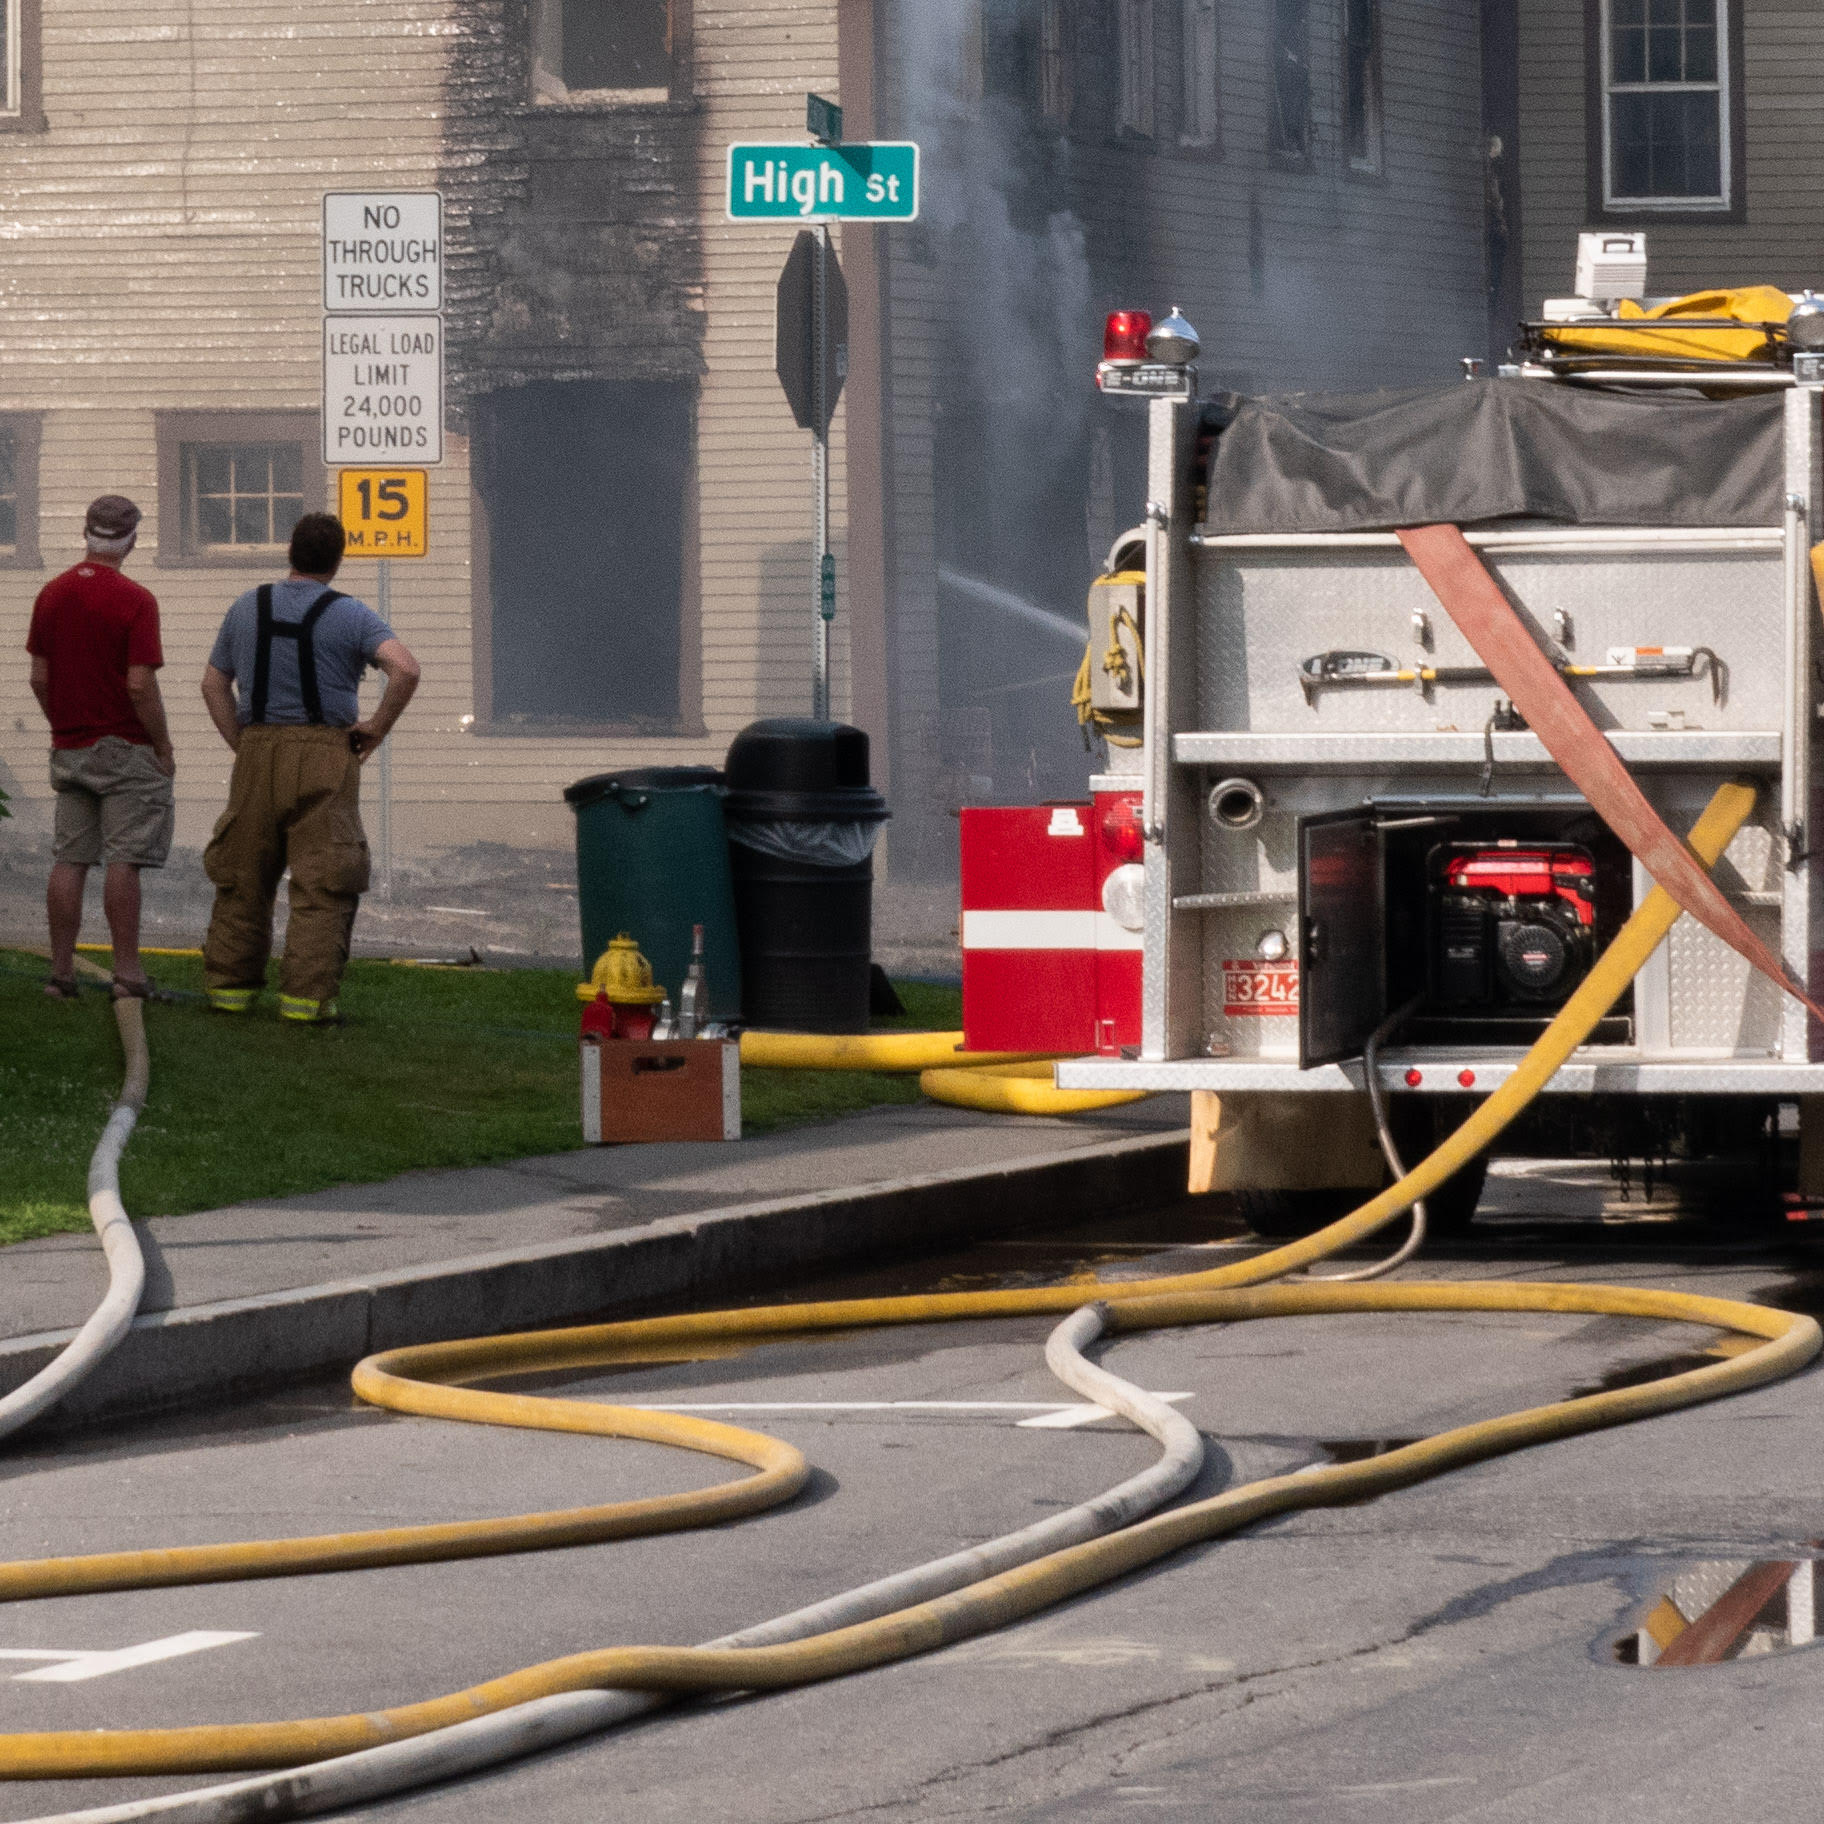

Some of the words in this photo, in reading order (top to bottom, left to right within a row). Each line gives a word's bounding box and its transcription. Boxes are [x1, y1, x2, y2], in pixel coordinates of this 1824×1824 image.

[743, 160, 844, 214] High
[865, 172, 900, 203] St
[364, 205, 401, 229] NO
[329, 240, 437, 264] THROUGH
[336, 274, 429, 298] TRUCKS
[330, 333, 381, 356] LEGAL
[391, 333, 434, 356] LOAD
[354, 364, 410, 386] LIMIT
[343, 395, 422, 420] 24,000
[338, 427, 428, 448] POUNDS
[356, 478, 410, 521] 15
[347, 531, 419, 547] M.P.H.
[1238, 974, 1300, 1001] 3242
